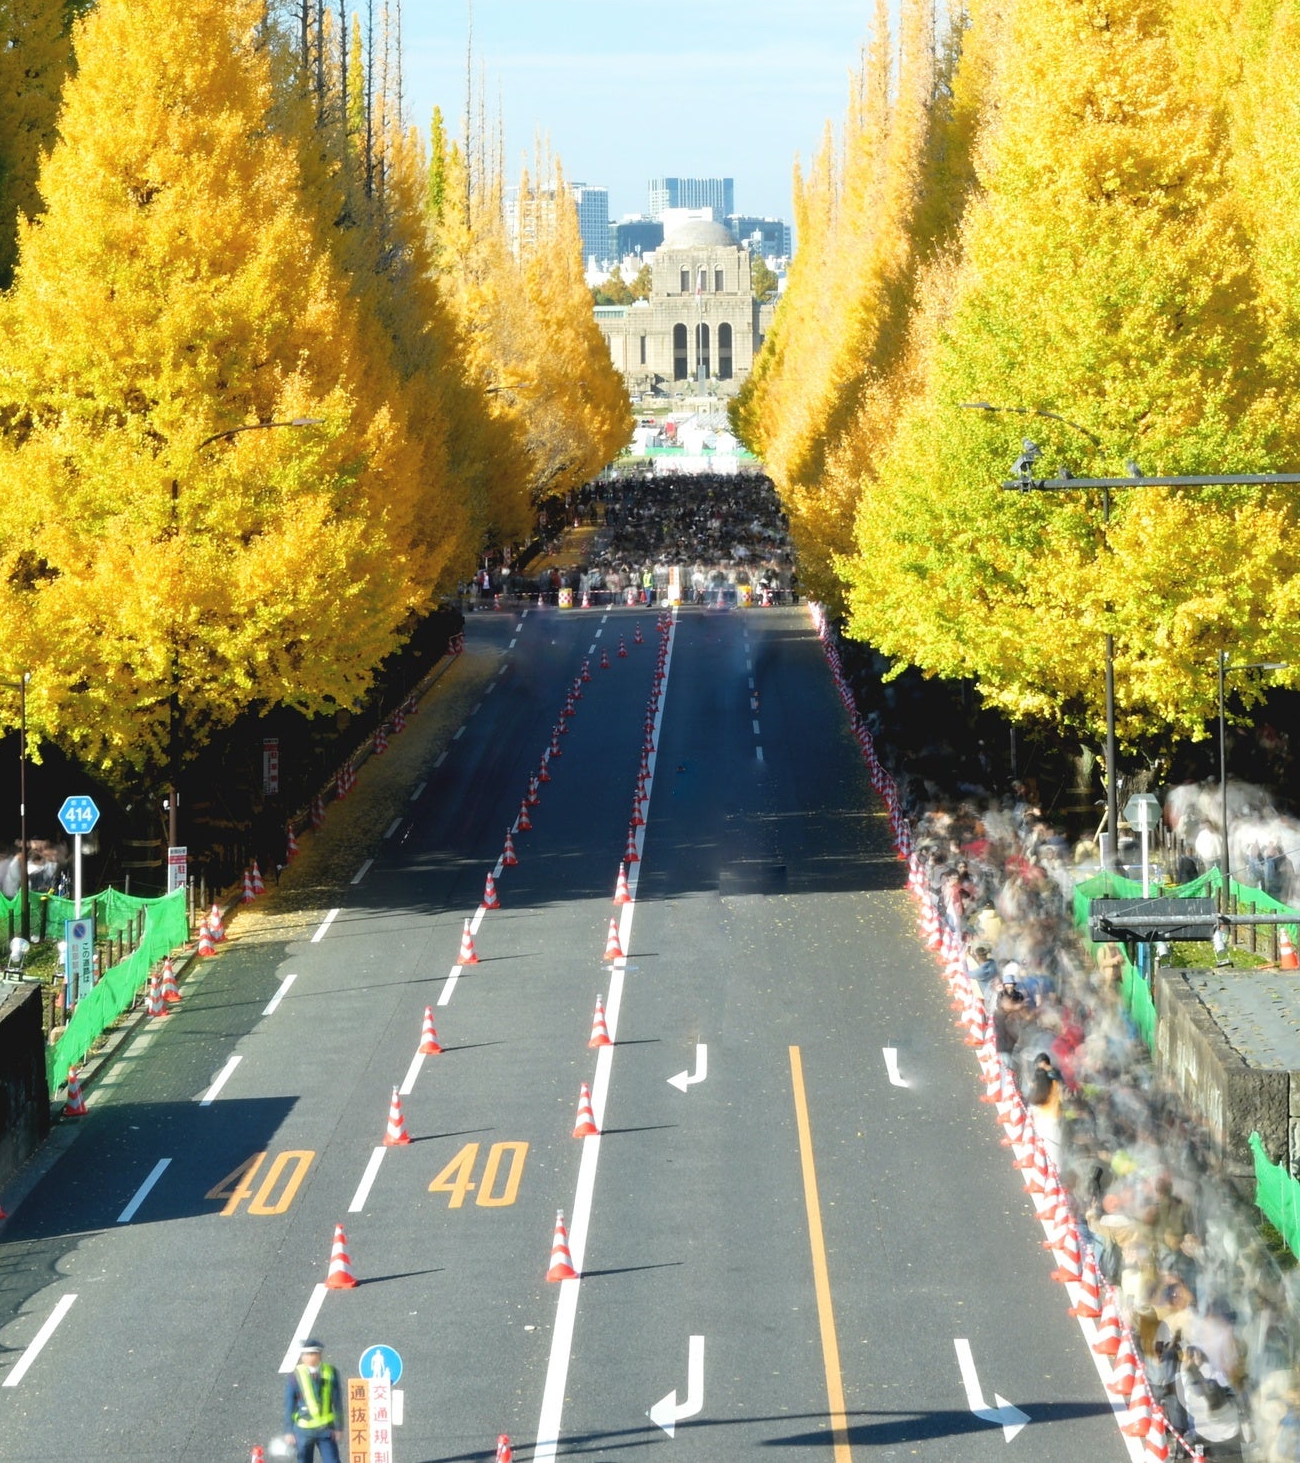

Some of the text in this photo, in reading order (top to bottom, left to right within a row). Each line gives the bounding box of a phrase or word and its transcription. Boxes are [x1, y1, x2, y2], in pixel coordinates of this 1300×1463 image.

[65, 807, 93, 822] 414
[204, 1150, 316, 1217] 40
[428, 1141, 529, 1209] 40
[350, 1385, 367, 1463] 通抜不可
[372, 1385, 389, 1463] 交通規制
